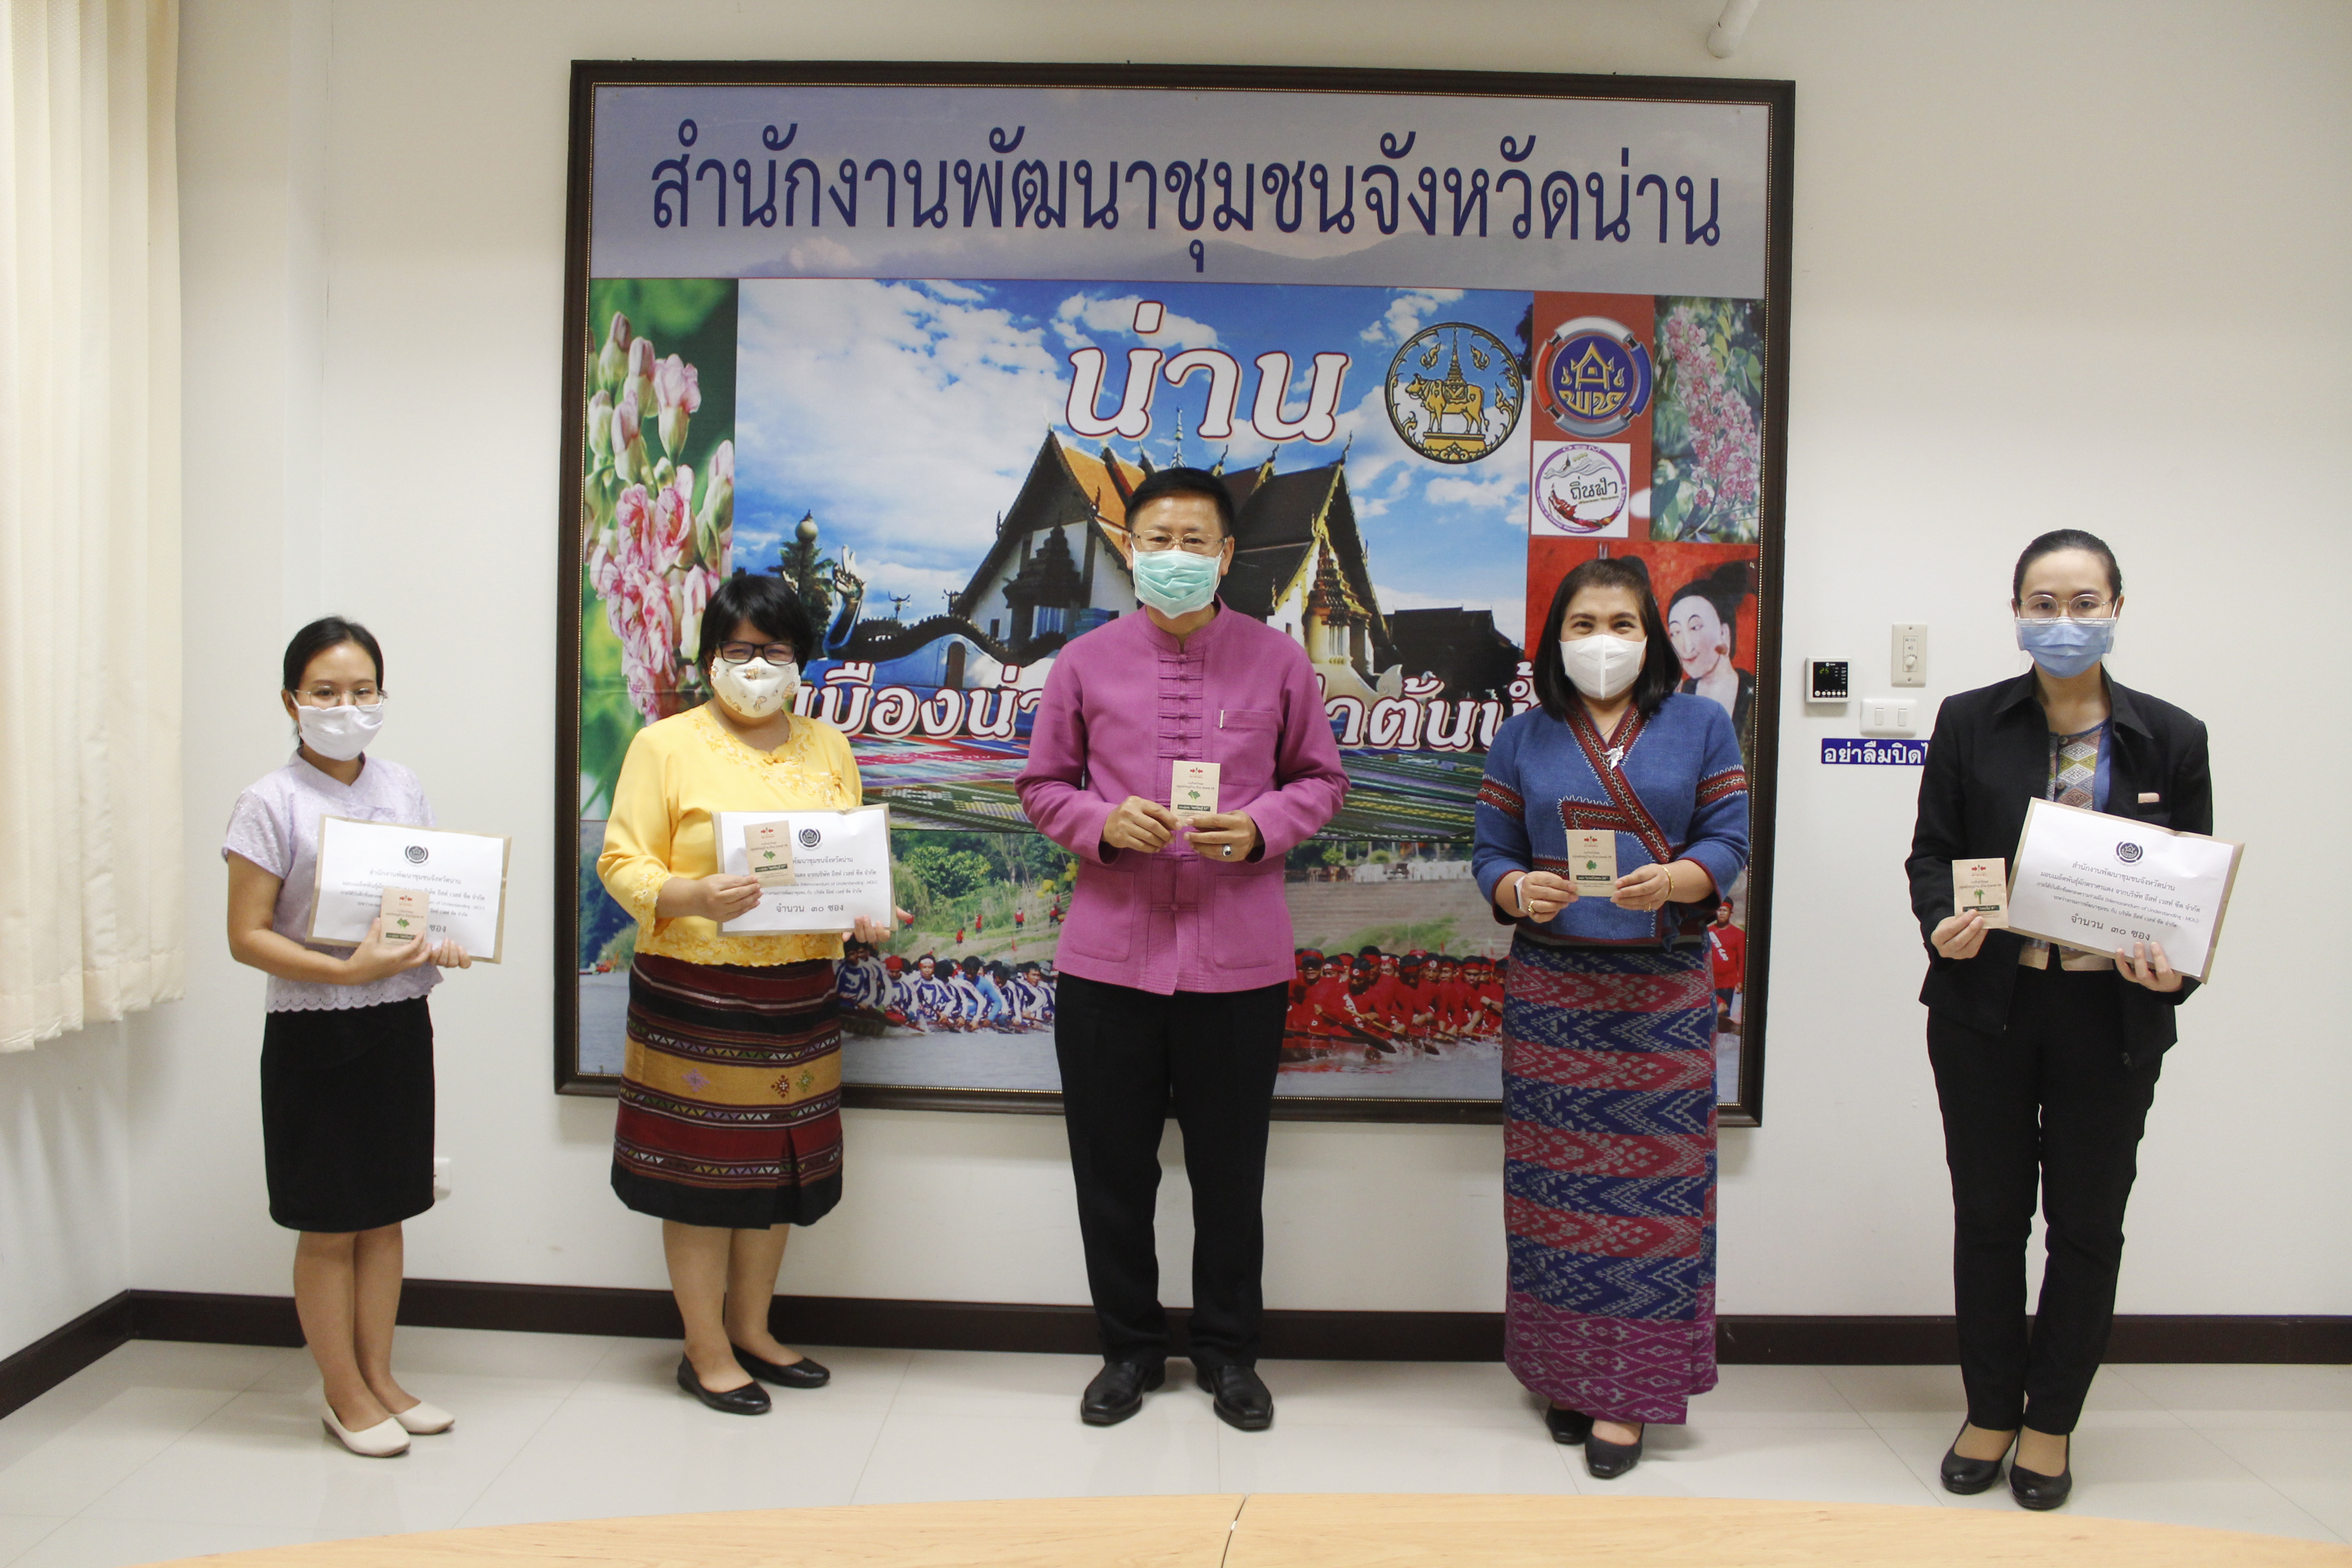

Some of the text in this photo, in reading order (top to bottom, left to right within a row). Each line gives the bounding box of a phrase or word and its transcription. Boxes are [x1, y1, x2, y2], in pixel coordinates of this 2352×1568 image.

[651, 118, 1720, 274] สำนักงานพัฒนาชุมชนจังหวัดน่าน
[1065, 300, 1353, 443] น่าน
[2072, 861, 2175, 891] สำนักงานพัฒนาชุมชนจังหวัดน่าน
[776, 902, 804, 912] จำนวน
[2105, 896, 2140, 909] (Memorandum
[2147, 908, 2181, 921] Understanding
[2116, 888, 2143, 899] จากบริษัท
[2185, 903, 2200, 913] จำกัด
[2071, 912, 2151, 941] จำนวน ๓๐ ซอง
